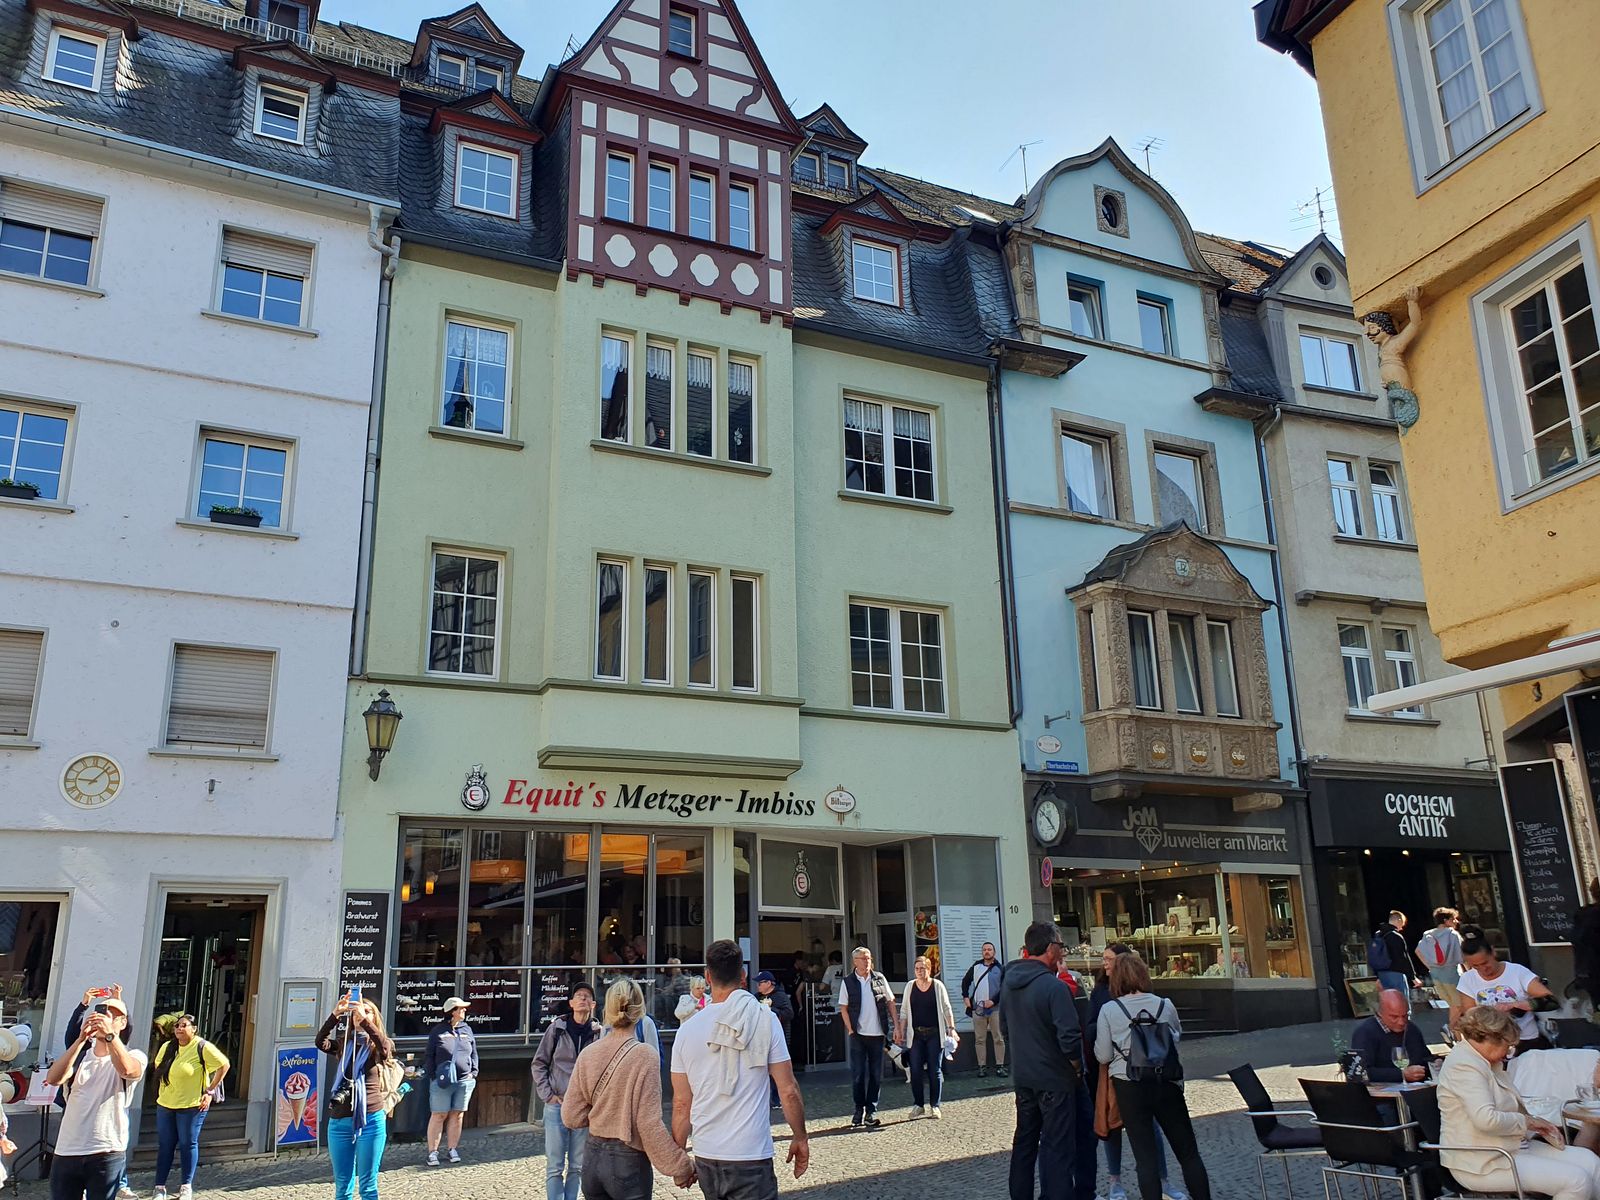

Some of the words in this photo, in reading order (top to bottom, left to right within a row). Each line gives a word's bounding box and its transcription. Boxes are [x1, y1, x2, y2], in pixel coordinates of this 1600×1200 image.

[614, 783, 816, 818] Metzger-Imbiss
[1384, 792, 1456, 818] COCHEM
[1398, 814, 1448, 838] ANTIK
[1161, 831, 1221, 850] Juwelier
[1223, 836, 1246, 851] am
[1247, 835, 1288, 852] Markt
[346, 897, 373, 906] Pommes
[1008, 904, 1019, 914] 10
[345, 911, 379, 920] Bratwurst
[344, 924, 381, 934] Frikadellen
[343, 938, 374, 947] Krakauer
[342, 952, 374, 961] Schnitzel
[341, 966, 382, 978] Spießbraten
